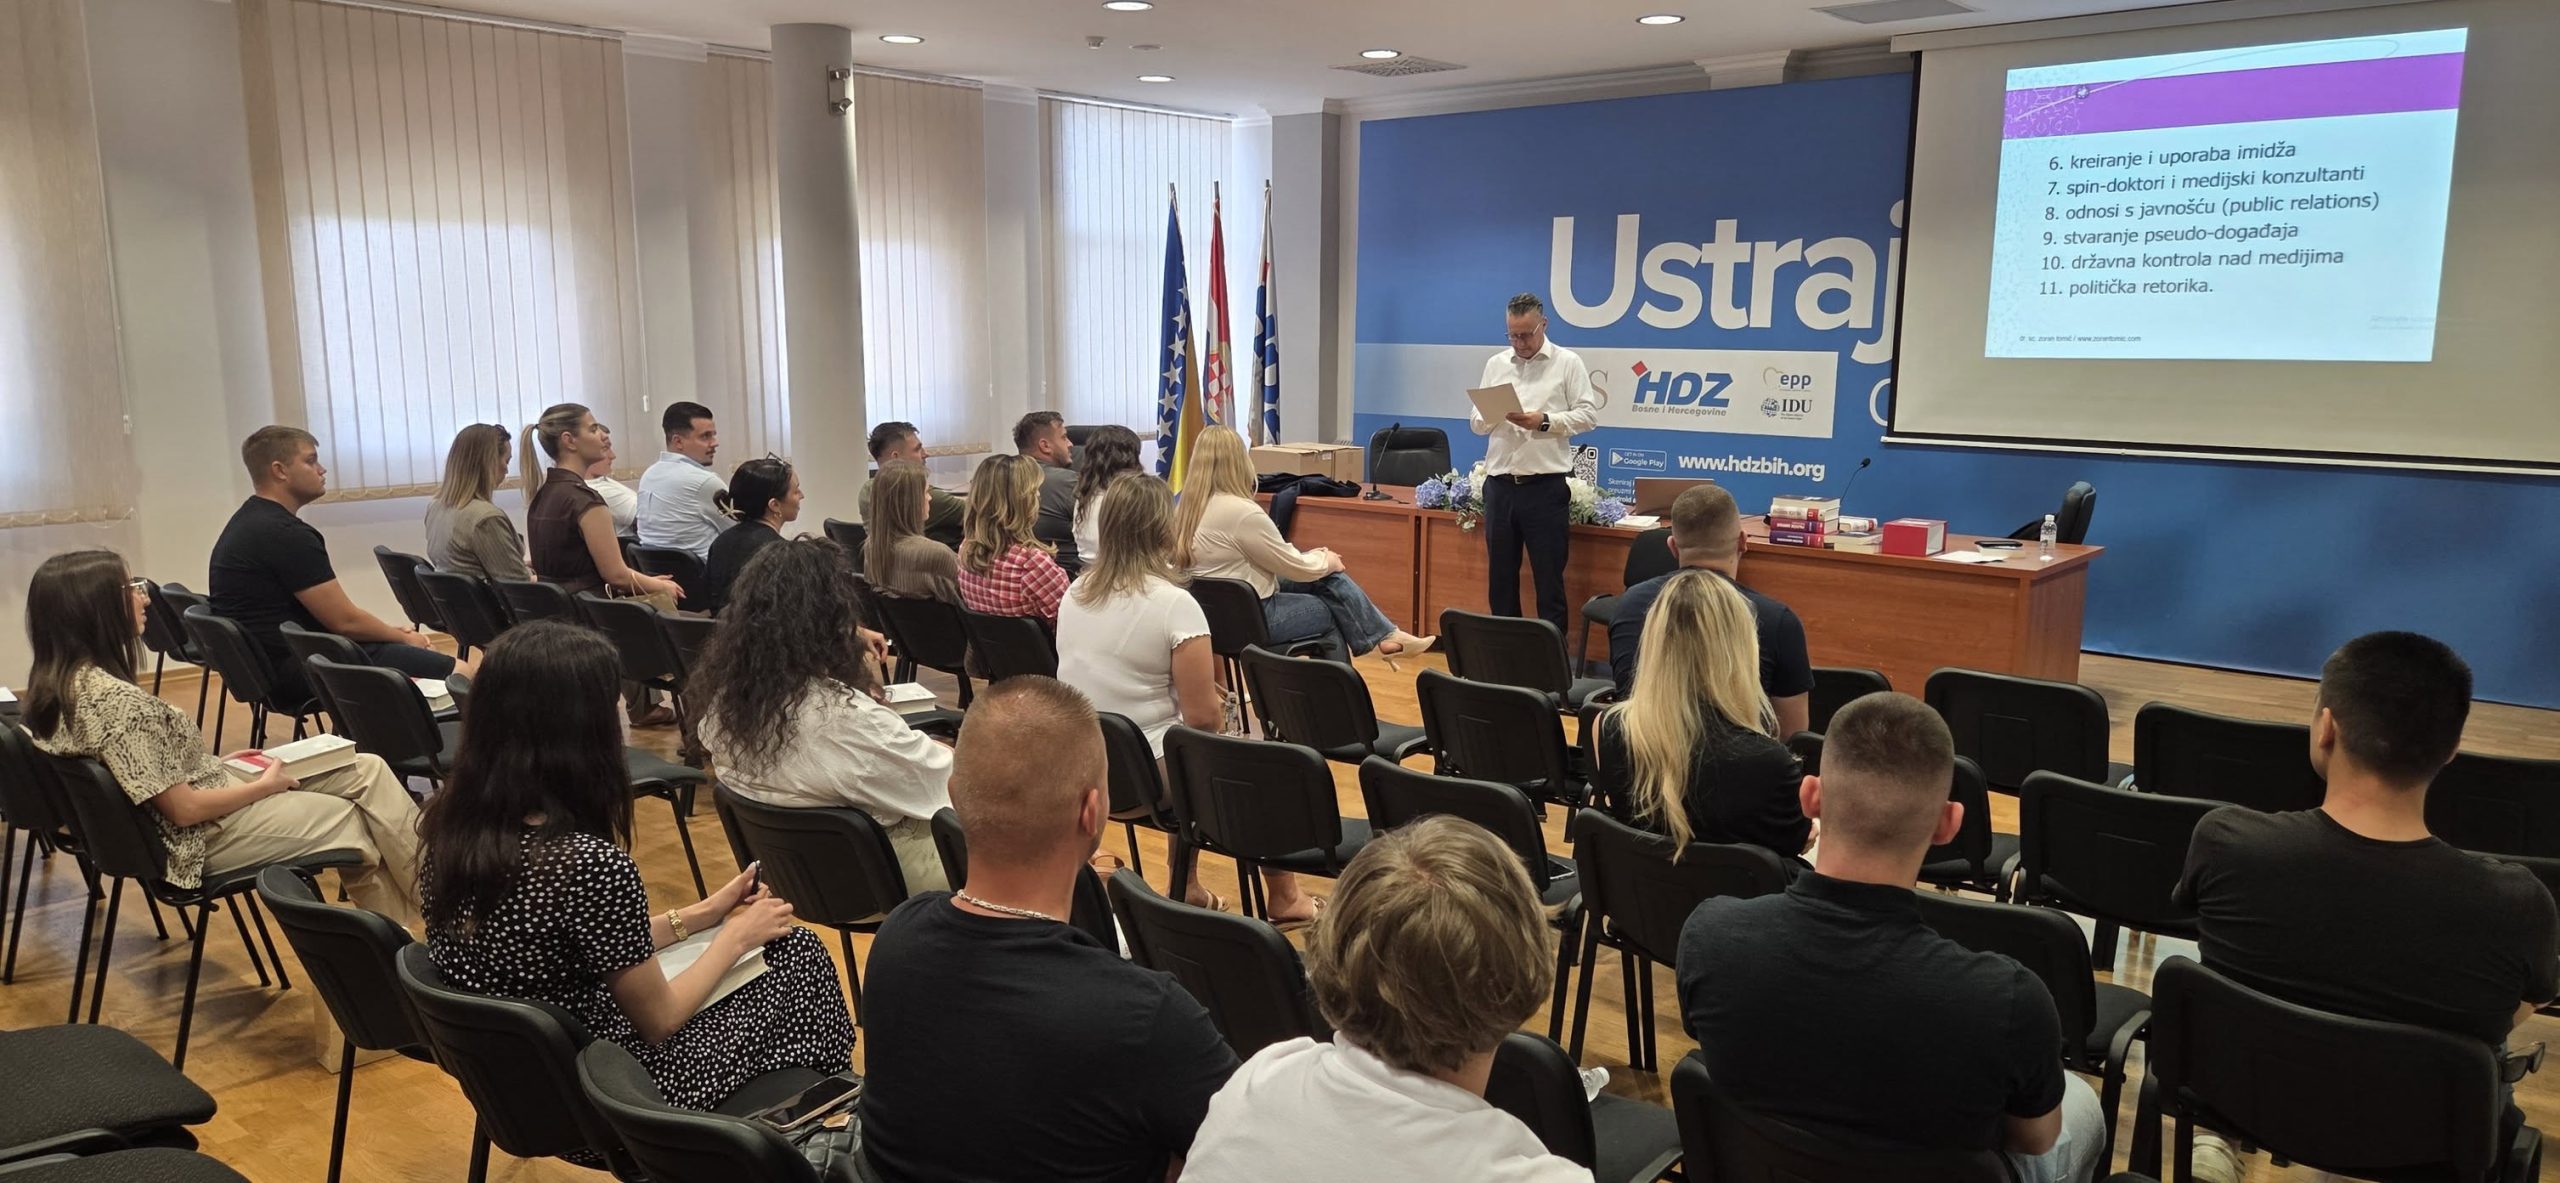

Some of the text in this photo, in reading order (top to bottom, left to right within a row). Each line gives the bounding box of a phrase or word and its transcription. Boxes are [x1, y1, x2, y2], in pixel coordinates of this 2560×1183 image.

[2049, 141, 2296, 171] 6. kreiranje i uporaba imidža
[2048, 166, 2365, 197] 7. spin-doktori i medijski konzultanti
[2045, 192, 2379, 220] 8. odnosi s javnošću (public relations)
[2043, 223, 2298, 246] 9. stvaranje pseudo-događaja
[2041, 249, 2344, 270] 10. državna kontrola nad medijima
[2039, 278, 2213, 297] 11. politička retorika.
[1633, 371, 1733, 408] HDZ
[1780, 374, 1811, 389] epp
[1632, 404, 1659, 413] Bosne
[1668, 406, 1727, 417] Hercegovine
[1781, 398, 1812, 413] IDU
[1624, 458, 1664, 468] Google Play
[1678, 454, 1825, 482] www.hdzbih.org
